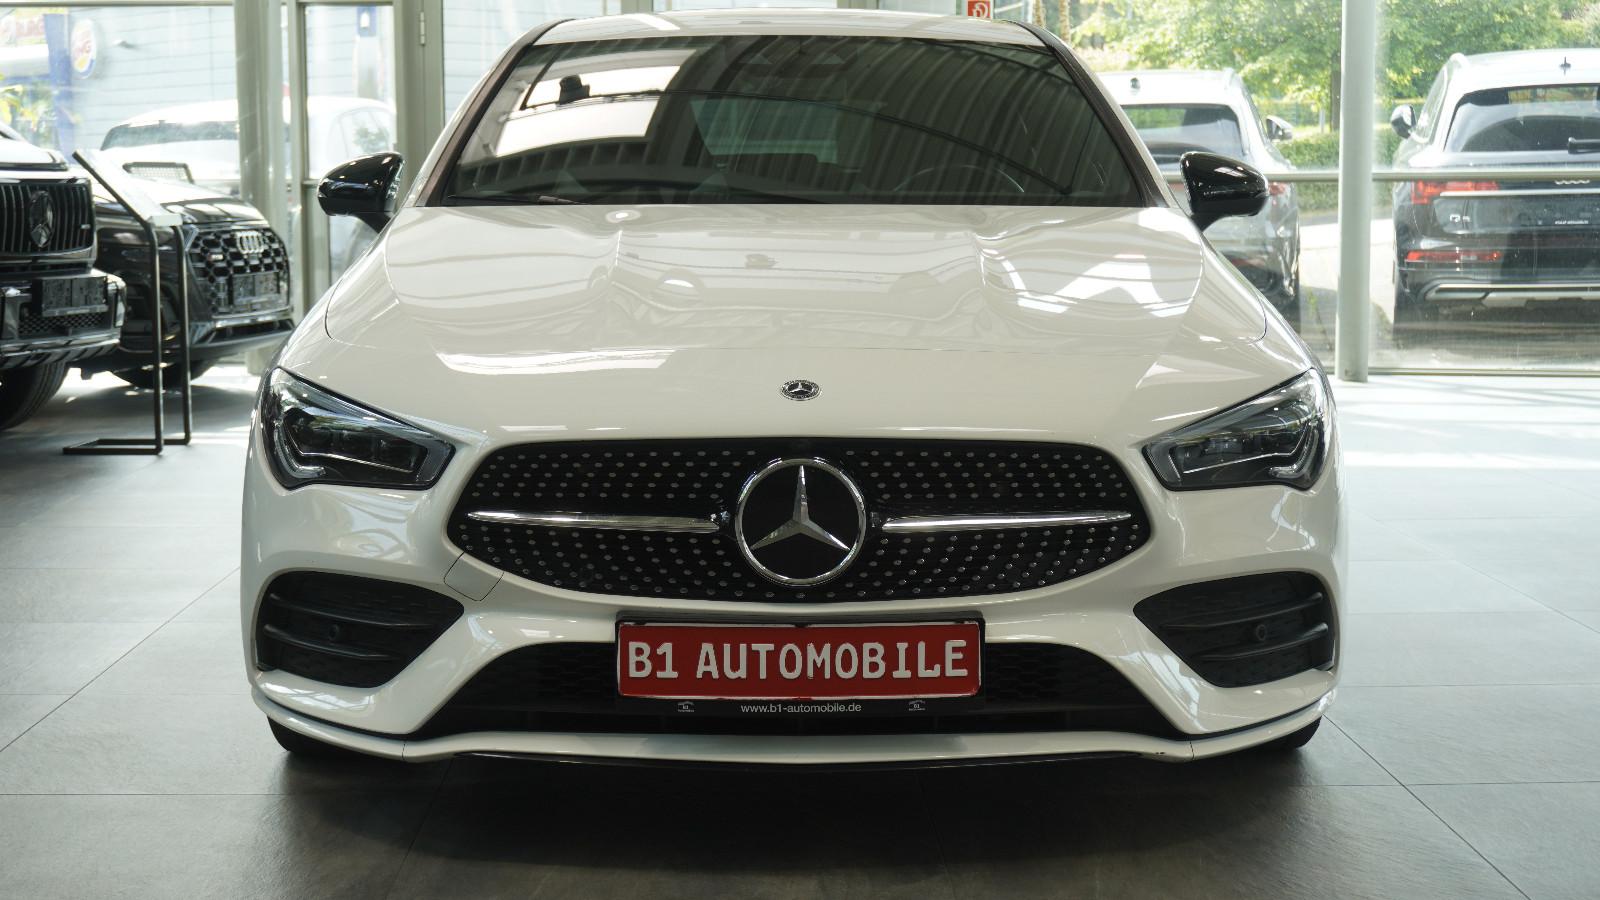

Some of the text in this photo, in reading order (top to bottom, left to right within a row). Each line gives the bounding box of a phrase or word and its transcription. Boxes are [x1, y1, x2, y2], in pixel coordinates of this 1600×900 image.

[628, 640, 969, 679] B1 AUTOMOBILE
[740, 703, 862, 713] www.b1-automobile.de
